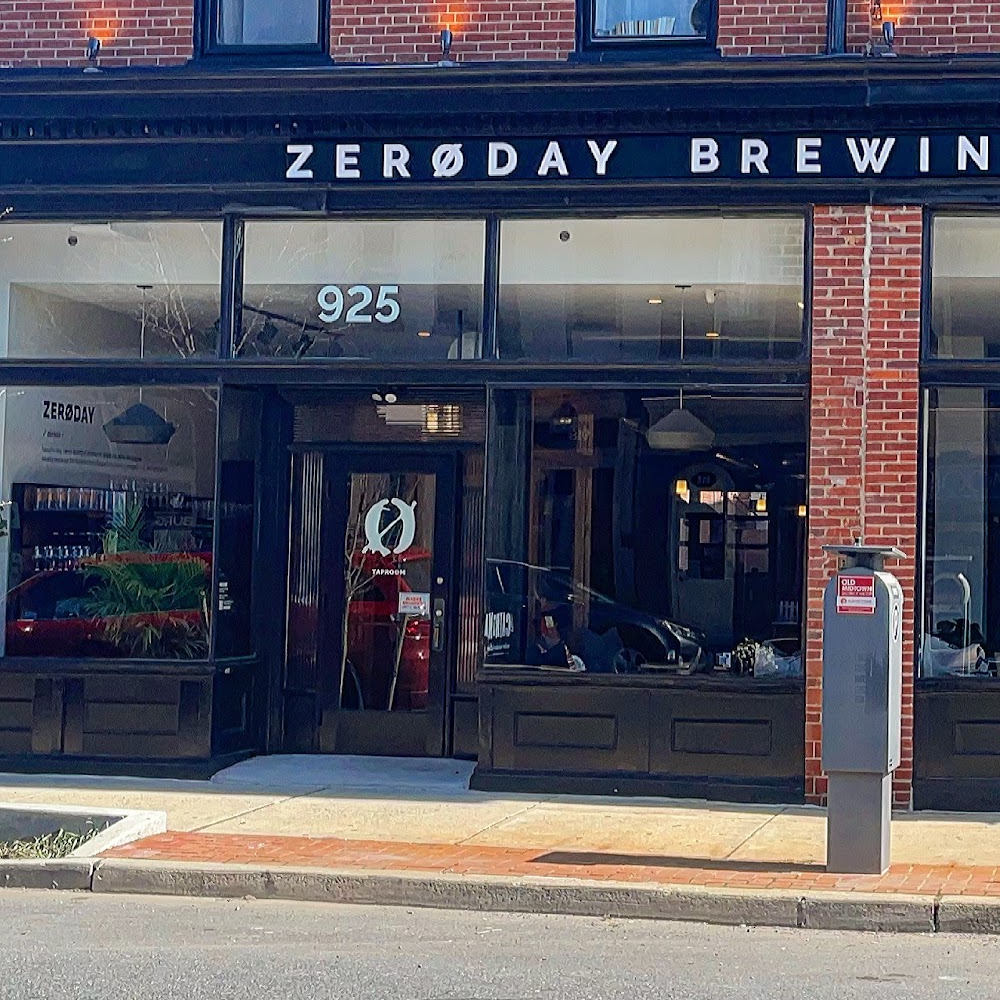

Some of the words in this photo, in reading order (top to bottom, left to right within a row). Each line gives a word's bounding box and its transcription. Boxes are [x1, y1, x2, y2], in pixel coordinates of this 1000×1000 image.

[286, 140, 618, 179] ZERØDAY
[317, 284, 401, 324] 925
[43, 400, 96, 424] ZERØDAY
[371, 568, 406, 576] TAPROOM
[841, 578, 856, 586] OLD
